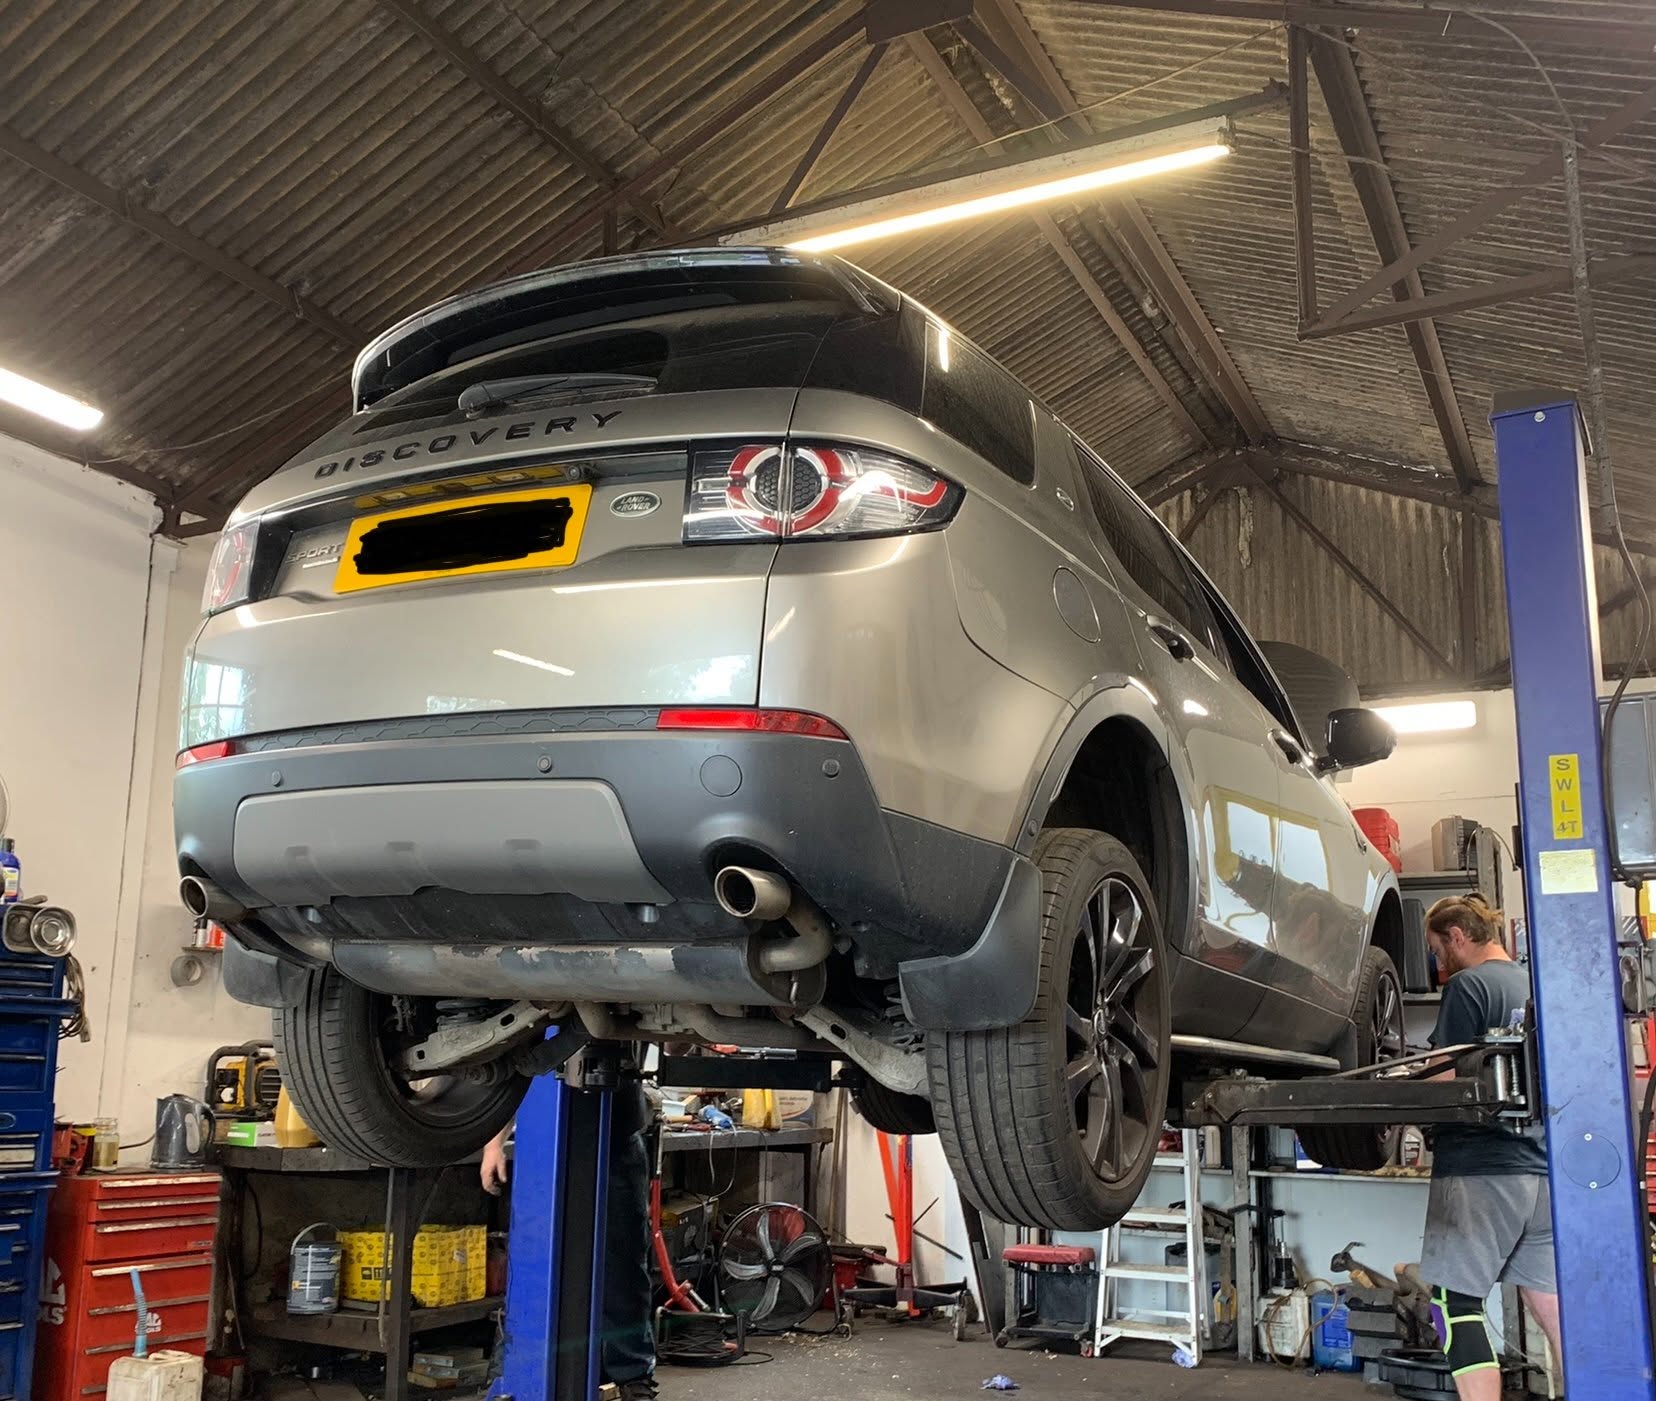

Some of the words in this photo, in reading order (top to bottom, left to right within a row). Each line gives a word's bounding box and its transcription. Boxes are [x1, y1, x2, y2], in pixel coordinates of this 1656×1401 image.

[314, 410, 622, 479] DISCOVERY
[285, 542, 345, 564] SPORT
[1556, 820, 1578, 833] 4T
